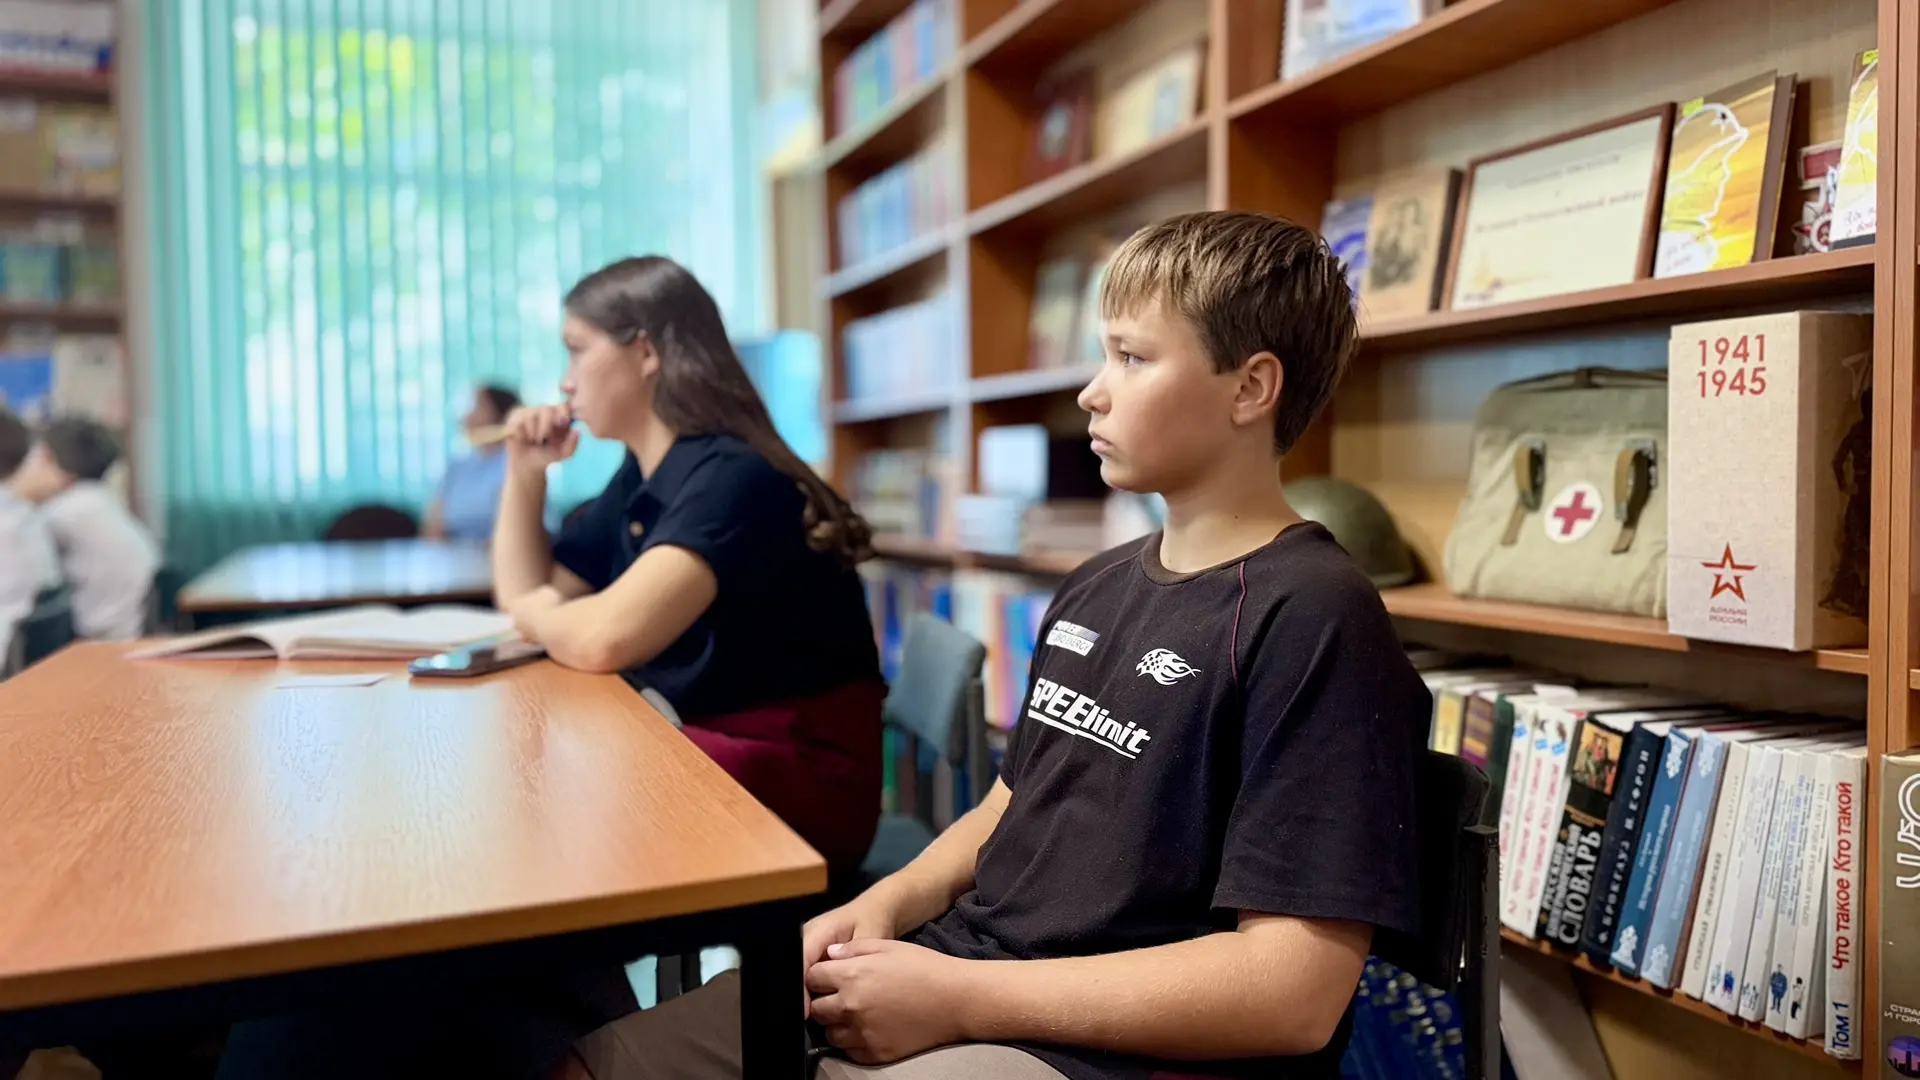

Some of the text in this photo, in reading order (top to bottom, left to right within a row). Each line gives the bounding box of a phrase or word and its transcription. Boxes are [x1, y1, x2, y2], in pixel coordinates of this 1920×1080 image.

[1698, 334, 1765, 366] 1941
[1697, 367, 1766, 398] 1945
[1709, 615, 1747, 626] РОССИИ
[1602, 840, 1630, 927] БРОКГАУЗ
[1628, 750, 1650, 812] ЕФРОН
[1541, 841, 1566, 911] РУССКИЙ
[1558, 831, 1601, 944] СЛОВАРЬ
[1832, 782, 1852, 970] Что такое Кто такой
[1832, 1001, 1849, 1048] Том 1
[1883, 1010, 1893, 1018] И
[1890, 1003, 1920, 1016] СТРА
